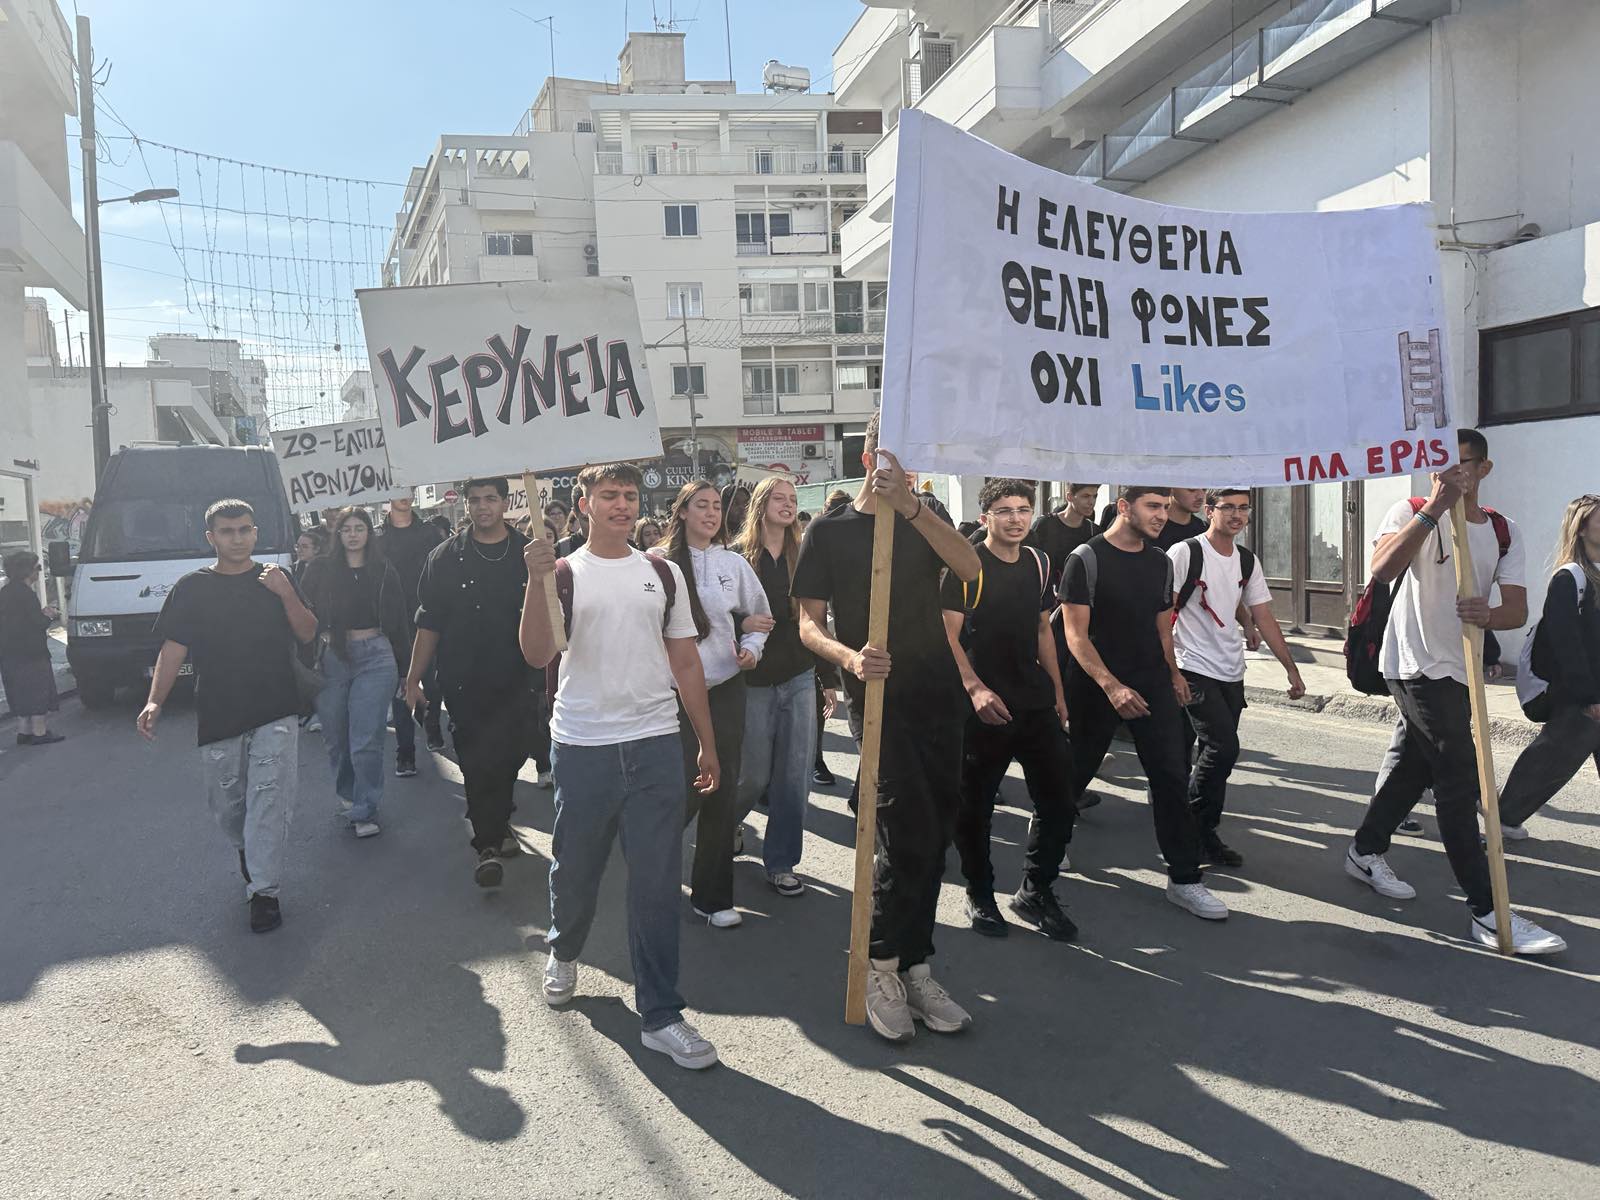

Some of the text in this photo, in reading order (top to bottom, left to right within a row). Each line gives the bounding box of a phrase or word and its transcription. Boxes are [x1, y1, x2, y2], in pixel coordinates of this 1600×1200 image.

[997, 185, 1243, 276] Η ΕΛΕΥΘΕΡΙΑ
[1002, 261, 1271, 348] ΘΕΛΕΙ ΦΩΝΕΣ
[376, 324, 645, 445] ΚΕΡΥΝΕΙΑ
[1031, 351, 1246, 413] ΟΧΙ Likes
[742, 428, 773, 436] MOBILE
[787, 427, 817, 435] TABLET
